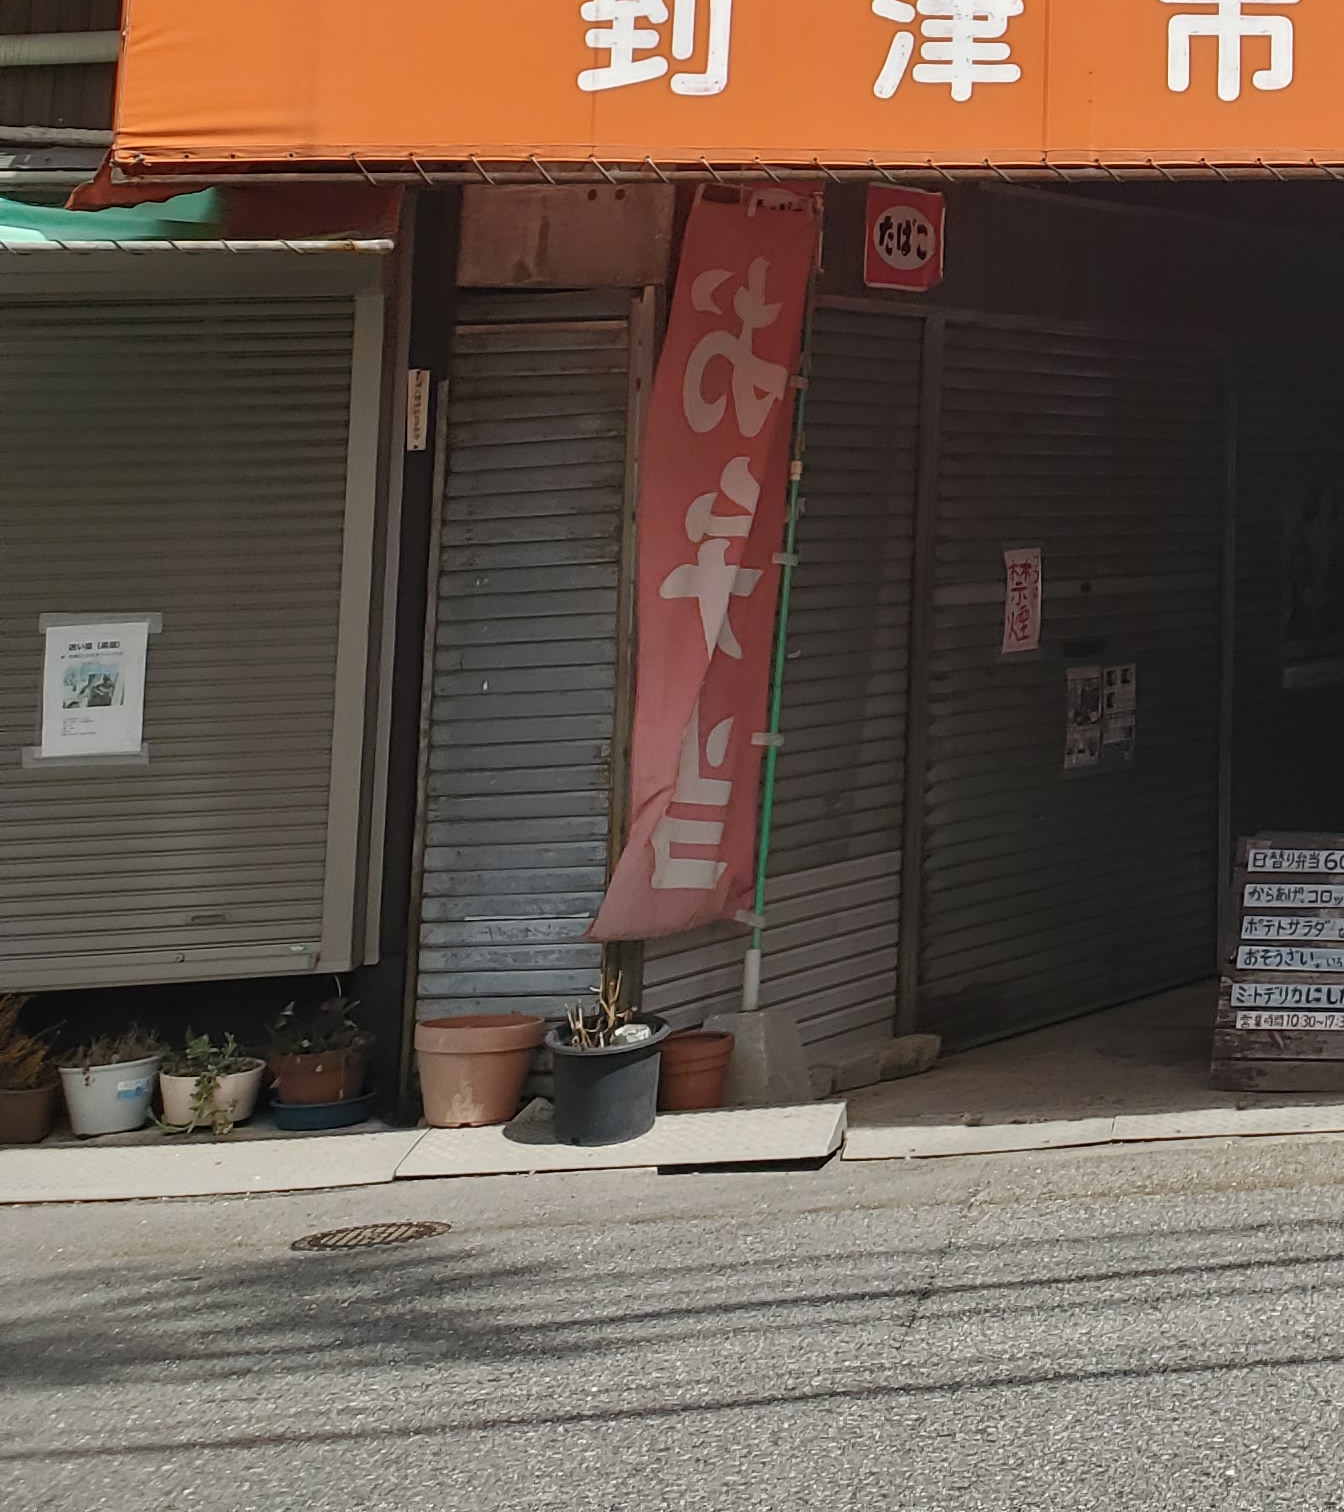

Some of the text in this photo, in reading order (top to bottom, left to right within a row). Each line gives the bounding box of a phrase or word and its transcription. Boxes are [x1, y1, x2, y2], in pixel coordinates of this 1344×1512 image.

[879, 215, 929, 261] たばこ
[1008, 558, 1033, 642] 禁煙
[1244, 919, 1331, 937] ポテトサラダ
